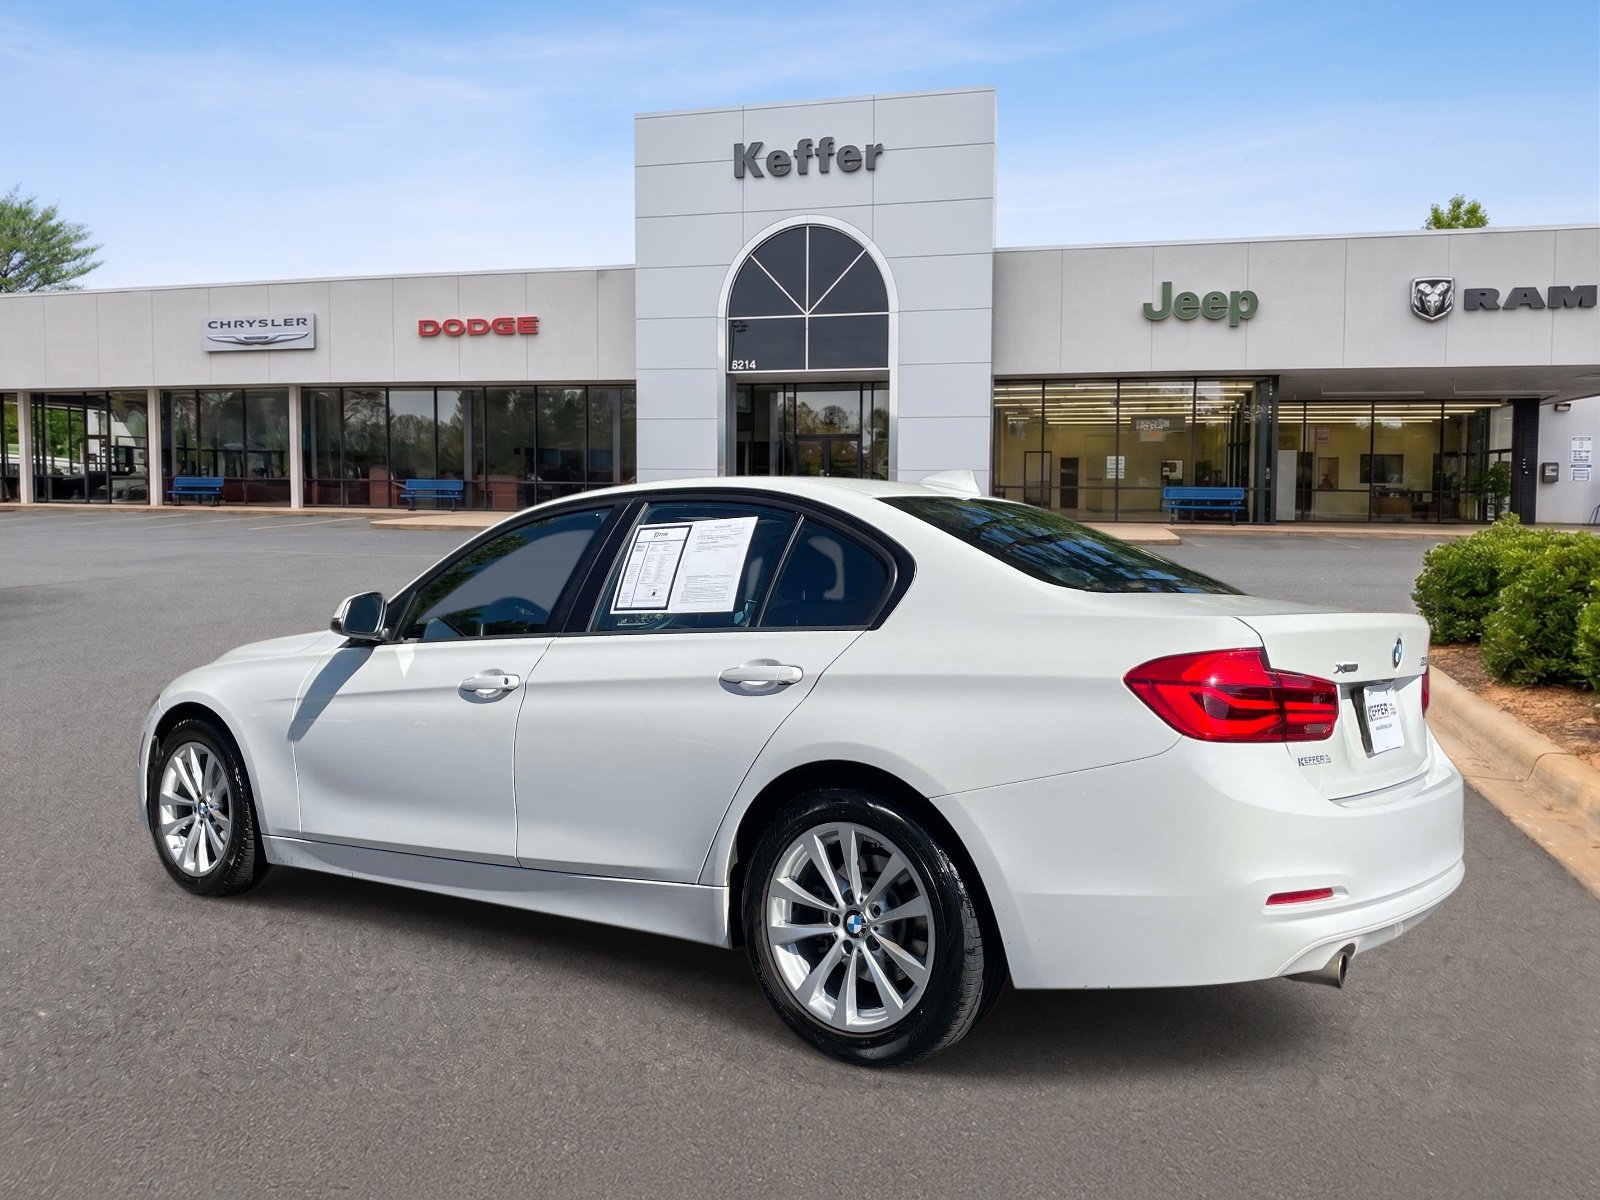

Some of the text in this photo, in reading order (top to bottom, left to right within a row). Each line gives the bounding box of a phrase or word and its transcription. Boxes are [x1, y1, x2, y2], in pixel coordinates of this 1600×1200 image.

[733, 136, 883, 179] Keffer
[1143, 281, 1259, 327] Jeep
[1464, 284, 1597, 311] RAM
[208, 318, 308, 329] CHRYSLER
[418, 316, 538, 337] DODGE
[732, 360, 756, 370] 8214
[1368, 703, 1388, 722] KEFFER
[1298, 755, 1324, 767] KEFFER
